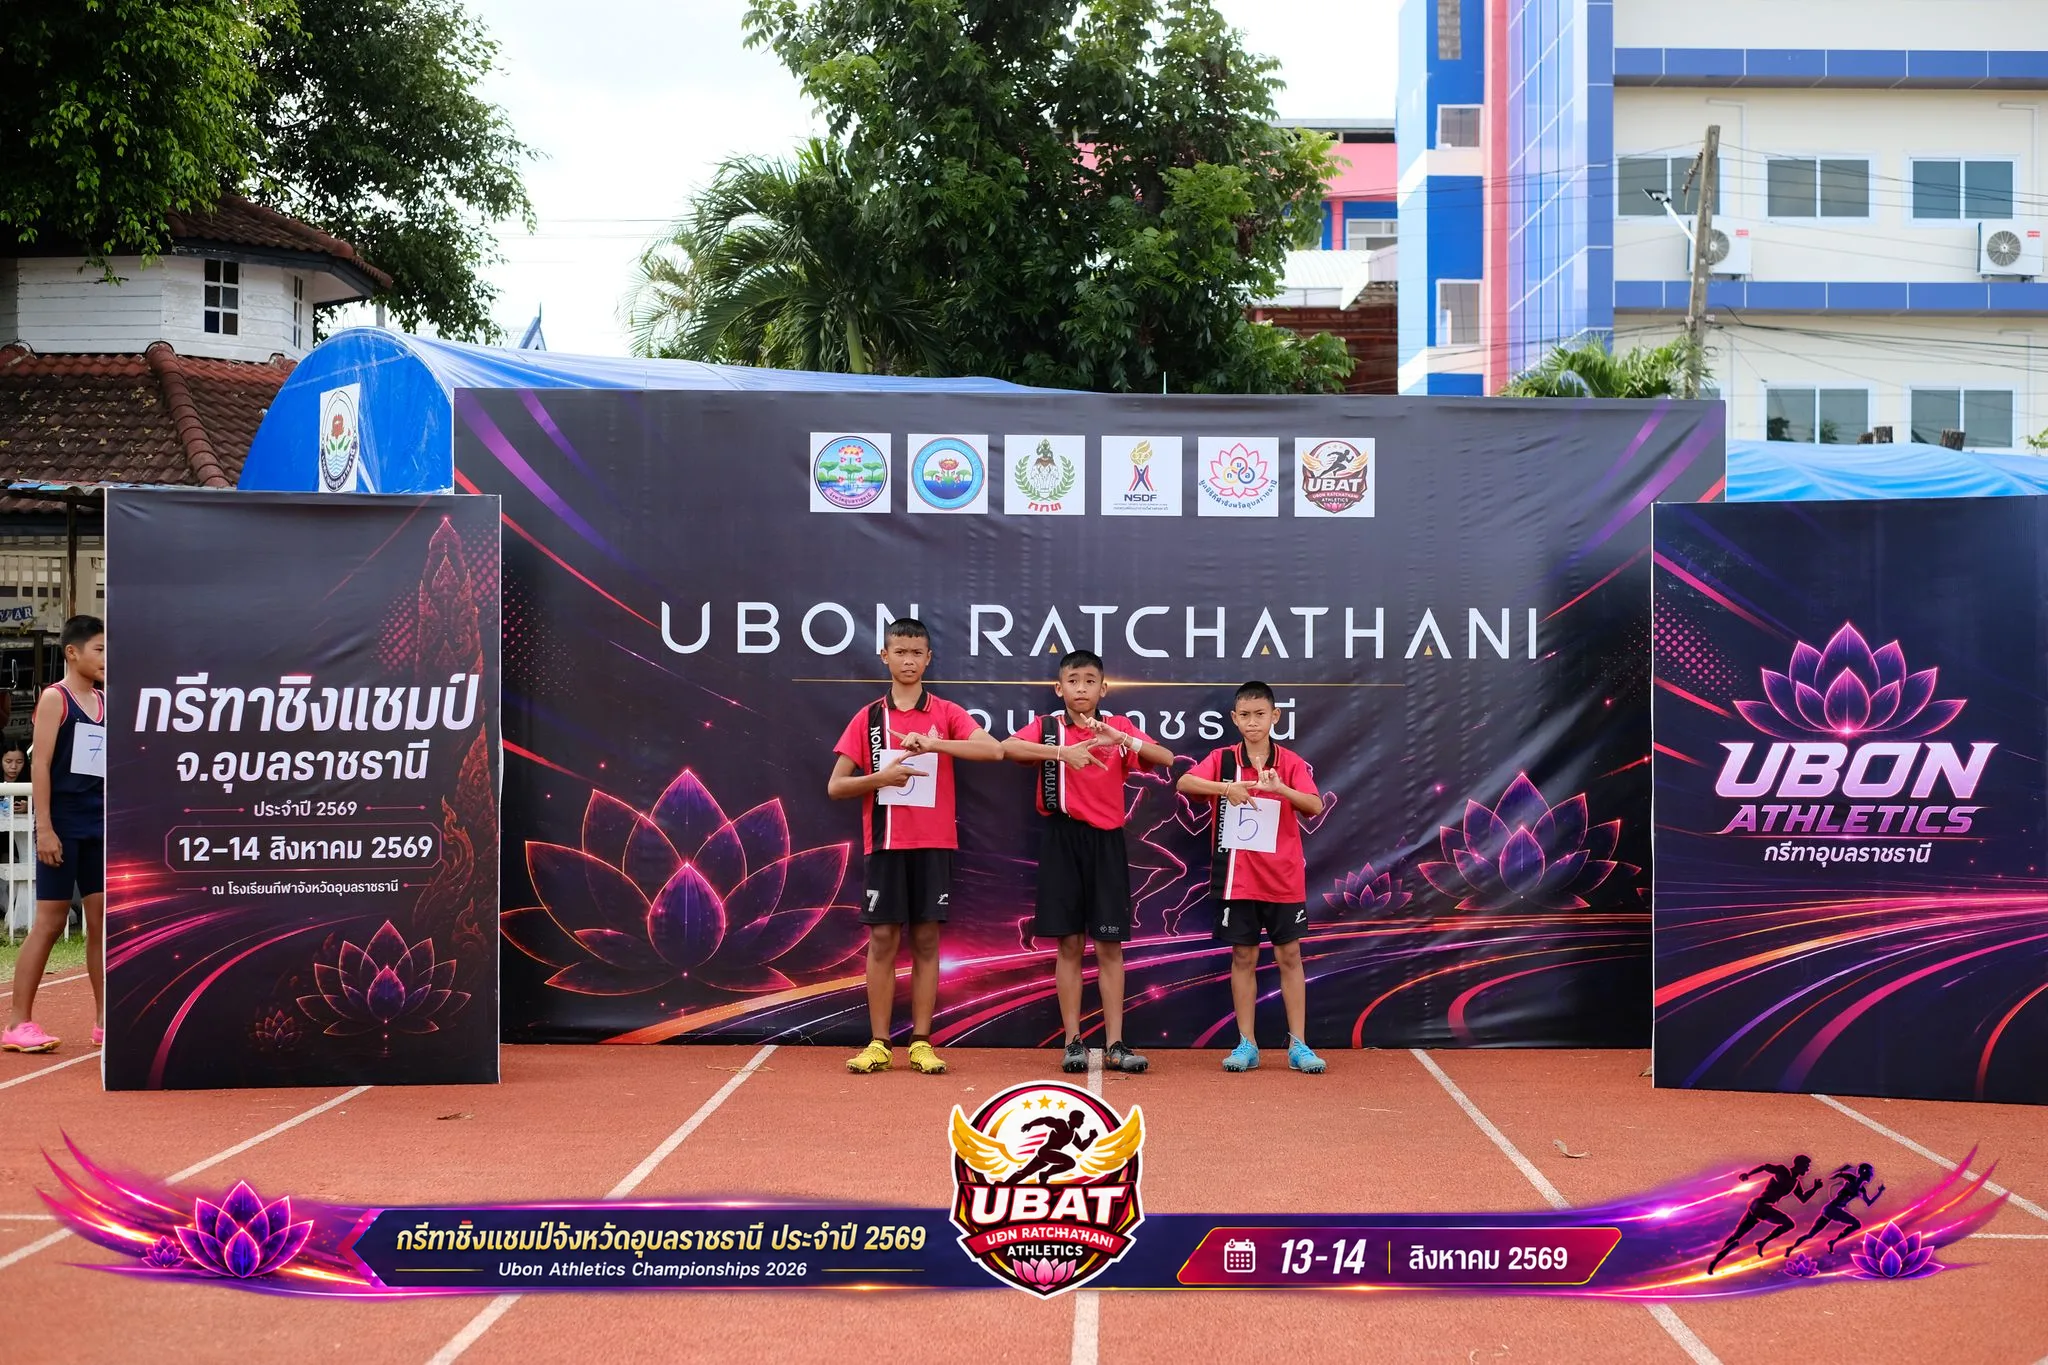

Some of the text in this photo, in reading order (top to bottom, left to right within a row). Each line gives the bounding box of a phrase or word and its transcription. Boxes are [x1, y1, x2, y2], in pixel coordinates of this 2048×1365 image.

[1124, 494, 1157, 502] NSDF
[1308, 478, 1363, 492] UBAT
[661, 601, 1537, 660] UBON RATCHATHANI
[134, 672, 480, 732] กรีฑาชิงแชมป์
[88, 734, 103, 761] 7
[176, 739, 430, 793] จ.อุบลราชธานี
[1716, 742, 1999, 799] UBON
[254, 799, 358, 817] ประจำปี 2569
[1718, 804, 1984, 834] ATHLETICS
[1237, 807, 1262, 842] 5
[269, 835, 362, 860] สิงหาคม
[371, 835, 433, 859] 2569
[212, 879, 399, 897] ณ โรงเรียนกีฬาจังหวัดอุบลราชธานี
[866, 889, 880, 912] 7
